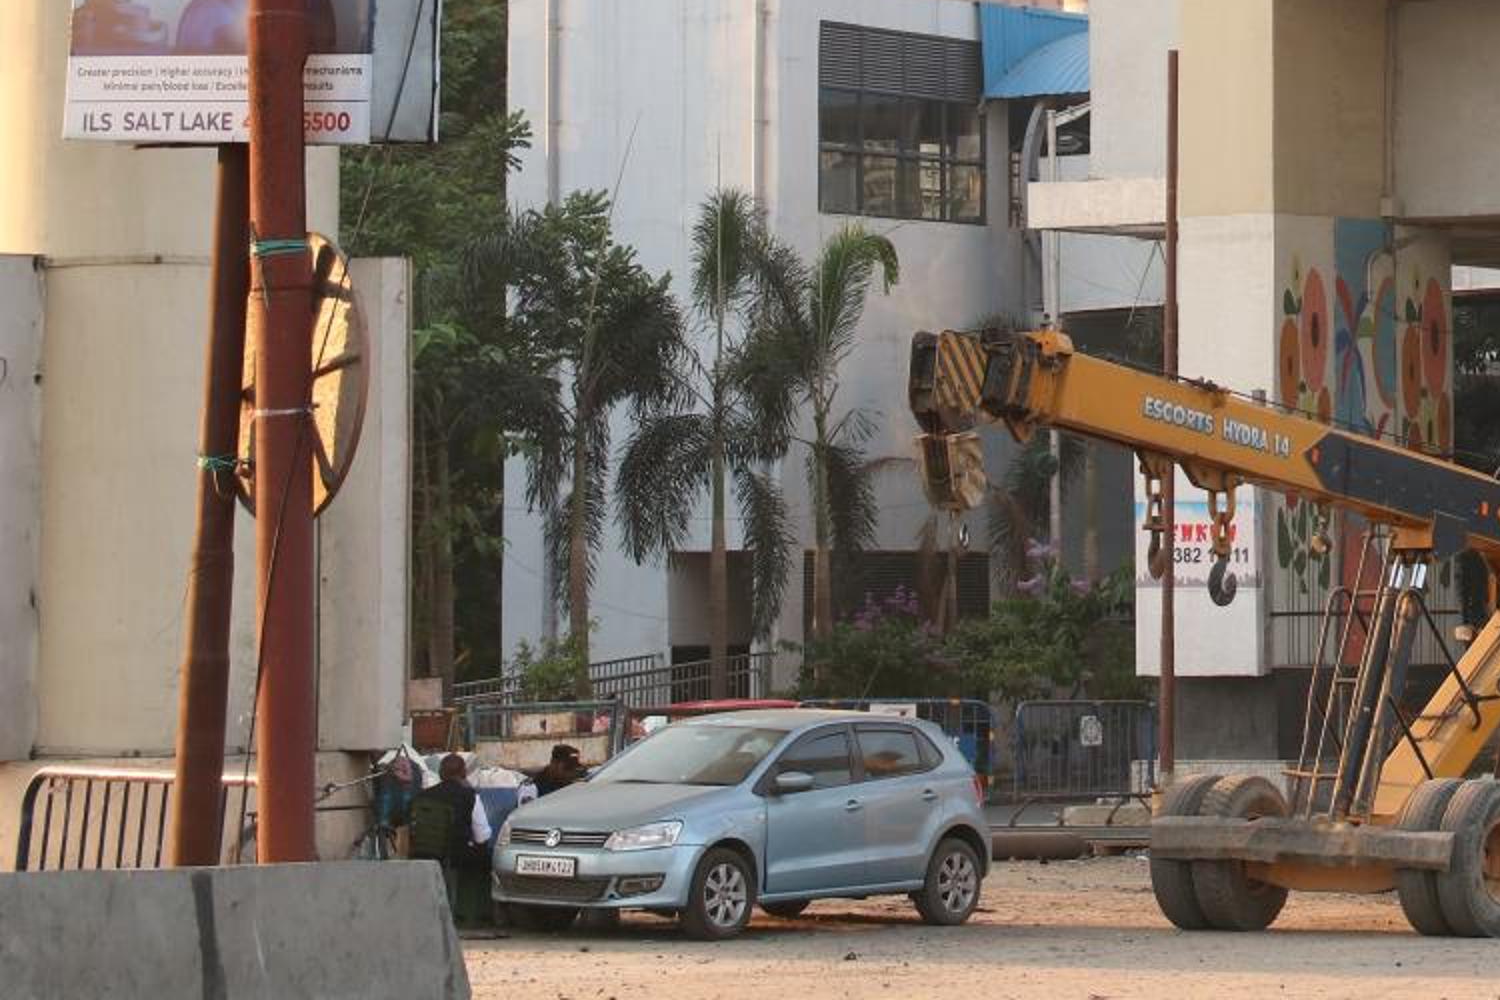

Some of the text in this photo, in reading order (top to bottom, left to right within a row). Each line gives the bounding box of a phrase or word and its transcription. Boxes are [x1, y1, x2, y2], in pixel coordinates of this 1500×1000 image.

[83, 112, 112, 132] ILS
[123, 112, 174, 132] SALT
[181, 112, 233, 131] LAKE
[1143, 397, 1214, 435] ESCORTS
[1222, 416, 1268, 450] HYDRA
